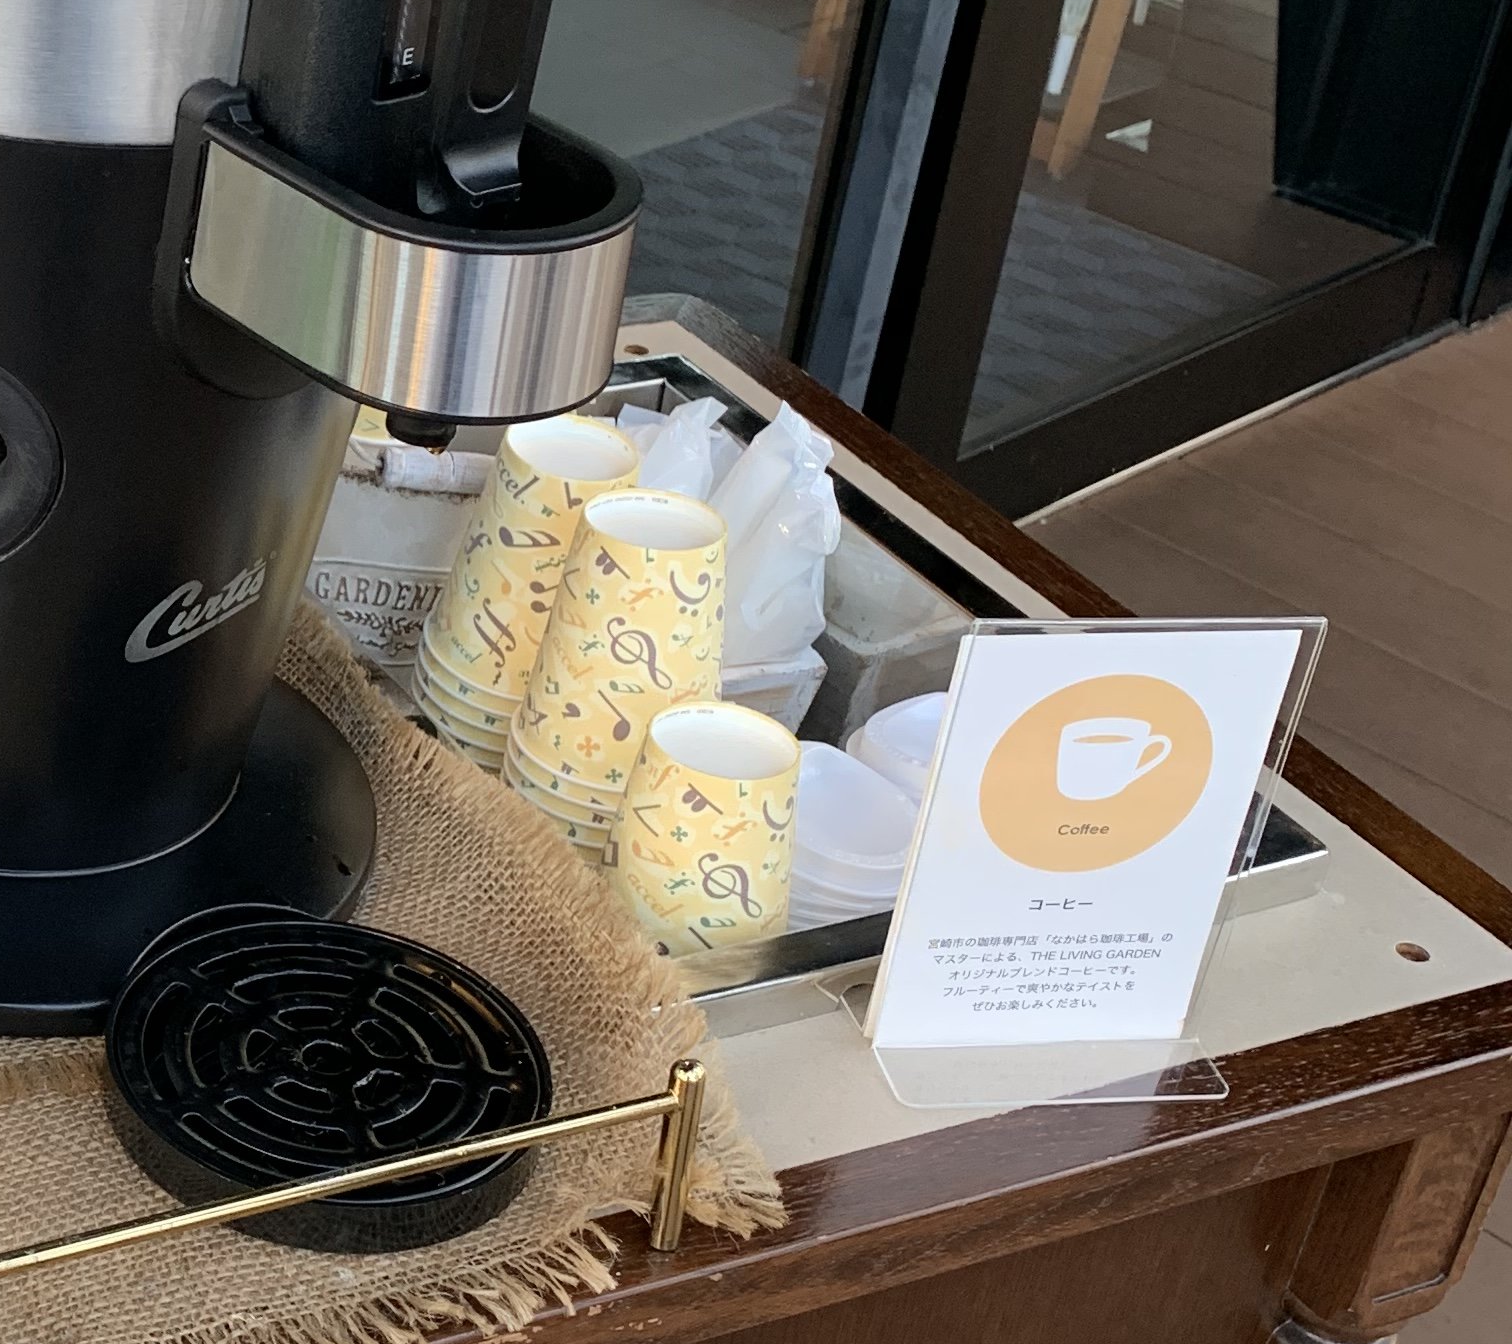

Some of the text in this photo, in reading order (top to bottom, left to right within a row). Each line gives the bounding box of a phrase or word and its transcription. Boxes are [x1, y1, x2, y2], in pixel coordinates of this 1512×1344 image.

[402, 47, 415, 66] E
[1058, 823, 1110, 836] Coffee
[1029, 898, 1093, 911] コーヒー
[1031, 951, 1057, 961] THE
[1060, 950, 1102, 960] LIVING
[1106, 949, 1162, 959] GARDEN
[948, 965, 1136, 981] オリジナルブレンドコーヒーです。
[972, 997, 1098, 1012] ぜひお楽しみください。
